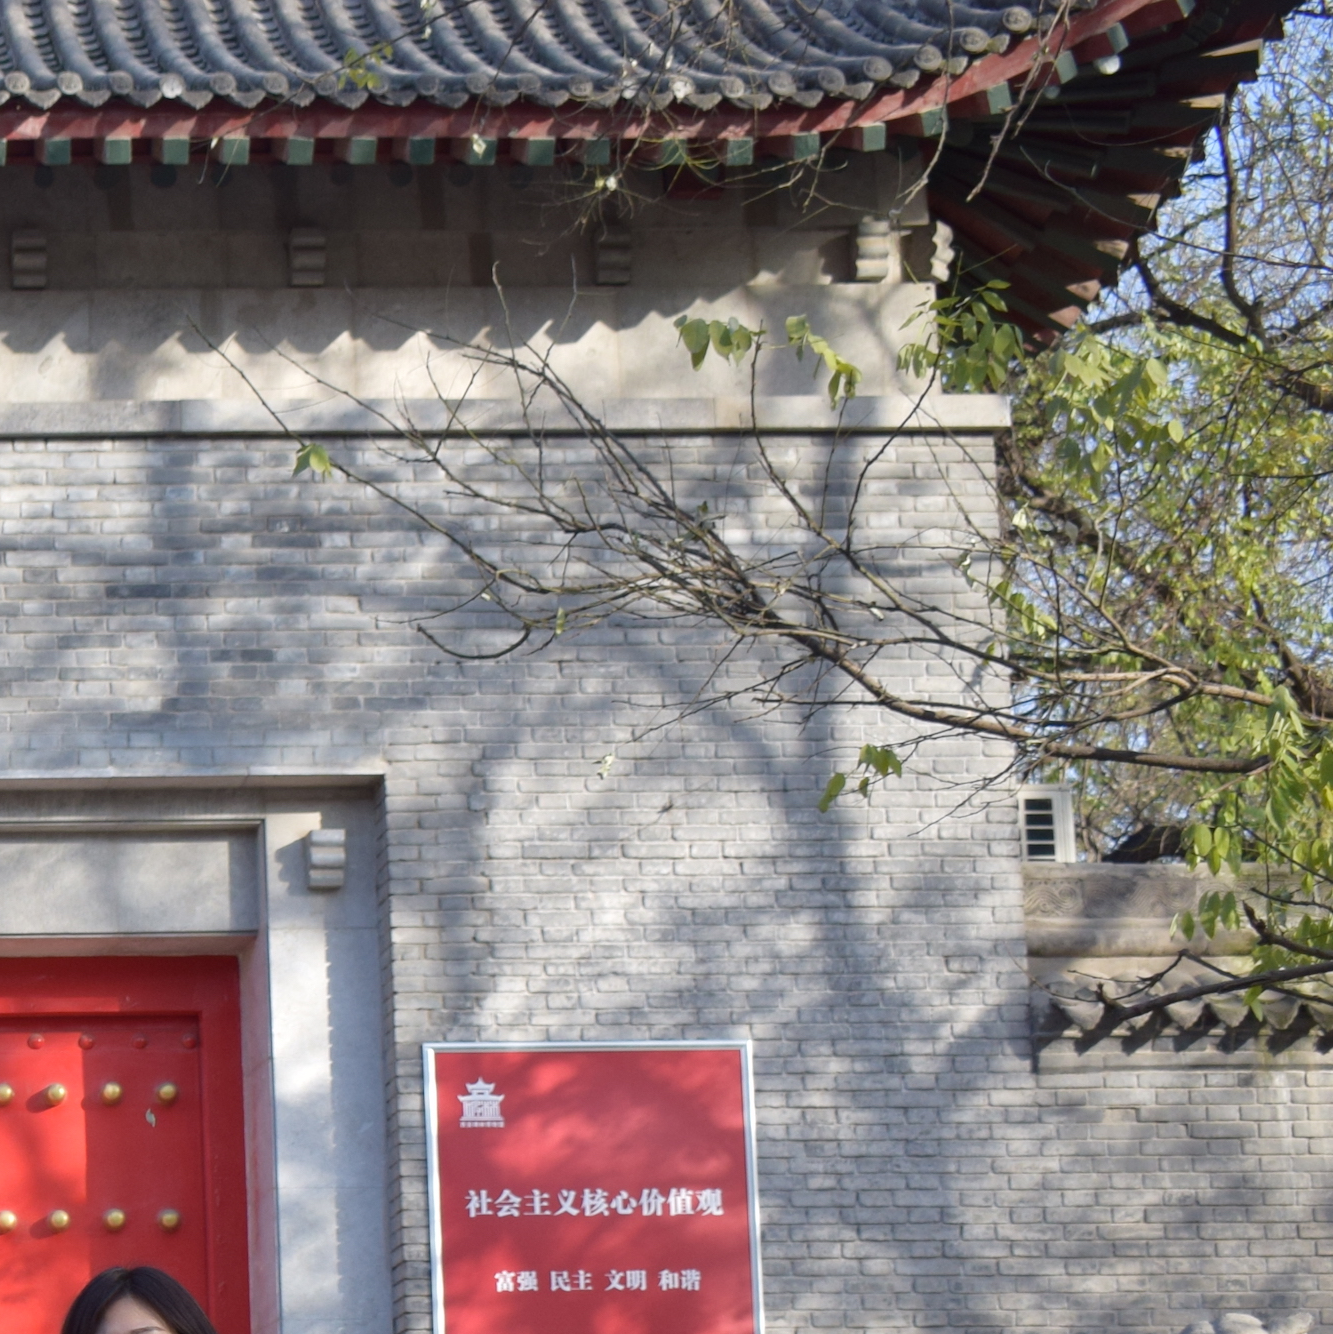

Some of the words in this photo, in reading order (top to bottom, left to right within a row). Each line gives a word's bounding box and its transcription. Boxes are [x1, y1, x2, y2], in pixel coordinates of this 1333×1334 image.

[465, 1187, 724, 1218] 社会主义核心价值观
[494, 1270, 539, 1292] 富强
[550, 1270, 593, 1291] 民主
[604, 1270, 647, 1291] 文明
[658, 1269, 702, 1291] 和谐
